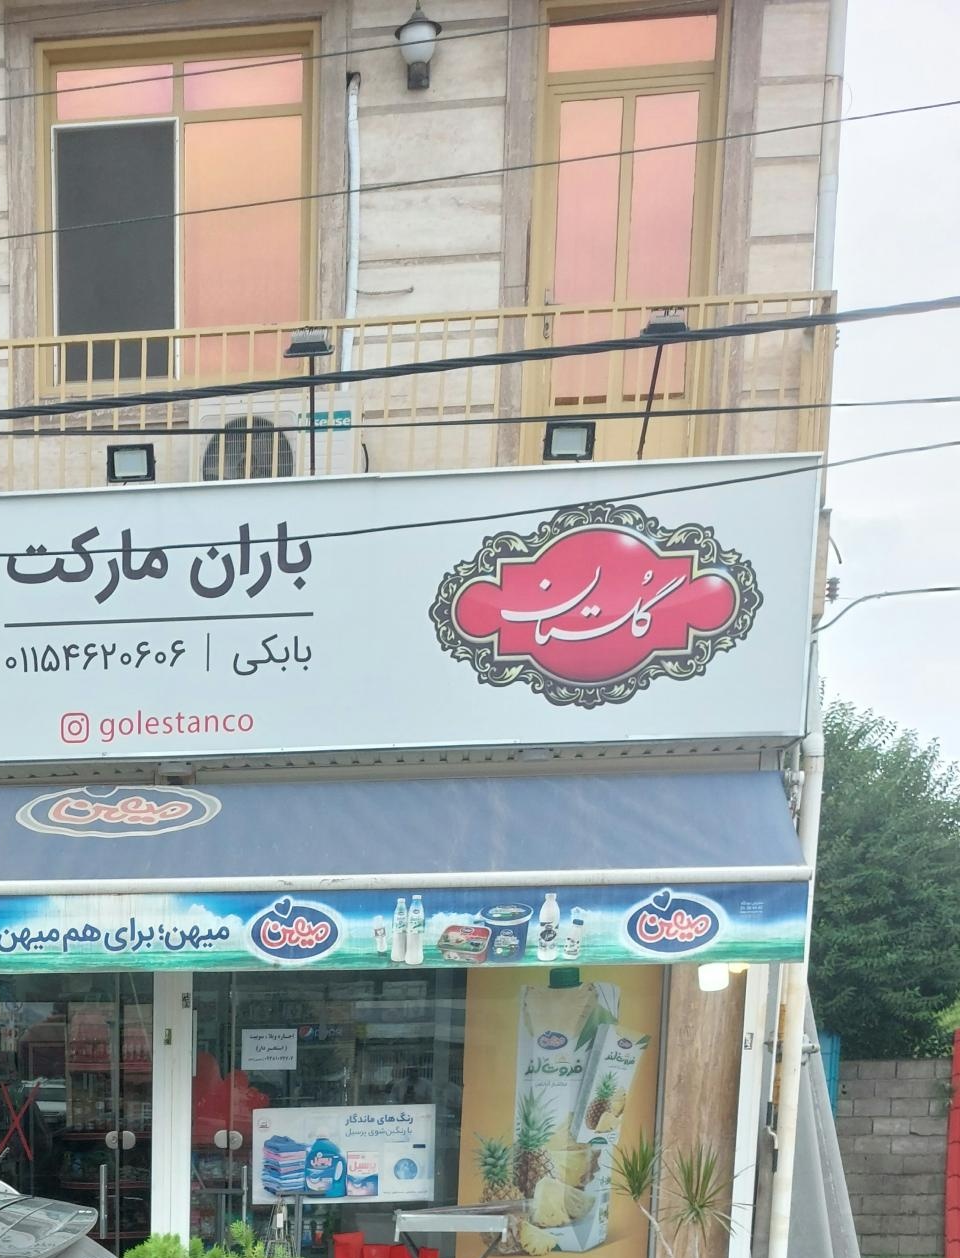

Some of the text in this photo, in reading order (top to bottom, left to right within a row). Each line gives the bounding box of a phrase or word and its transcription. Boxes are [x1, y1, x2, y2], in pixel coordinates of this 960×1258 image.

[6, 520, 313, 605] باران مارکت
[5, 633, 313, 676] بابکی ۰۱۱۵۴۶۲۰۶۰۶
[99, 709, 255, 743] golestanco
[48, 796, 193, 826] میهن
[62, 923, 102, 953] هم
[103, 917, 155, 952] برای
[260, 916, 331, 950] میهن
[636, 908, 712, 943] میهن
[344, 1111, 414, 1127] رنگ های ماندگار
